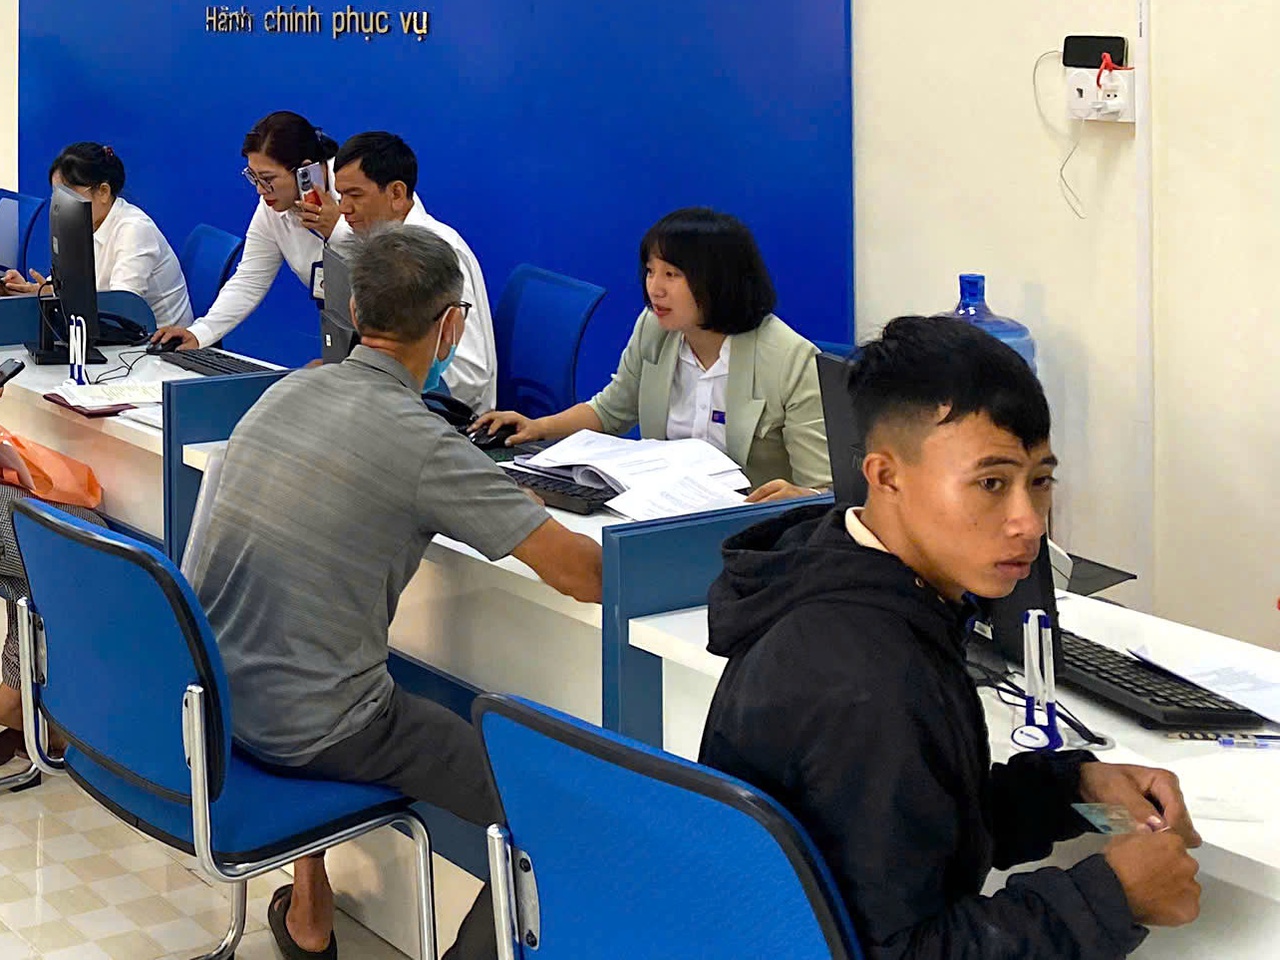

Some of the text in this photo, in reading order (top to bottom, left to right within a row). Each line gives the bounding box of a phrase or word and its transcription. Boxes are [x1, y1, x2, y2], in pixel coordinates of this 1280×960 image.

[206, 5, 429, 42] Hành chính phục vụ
